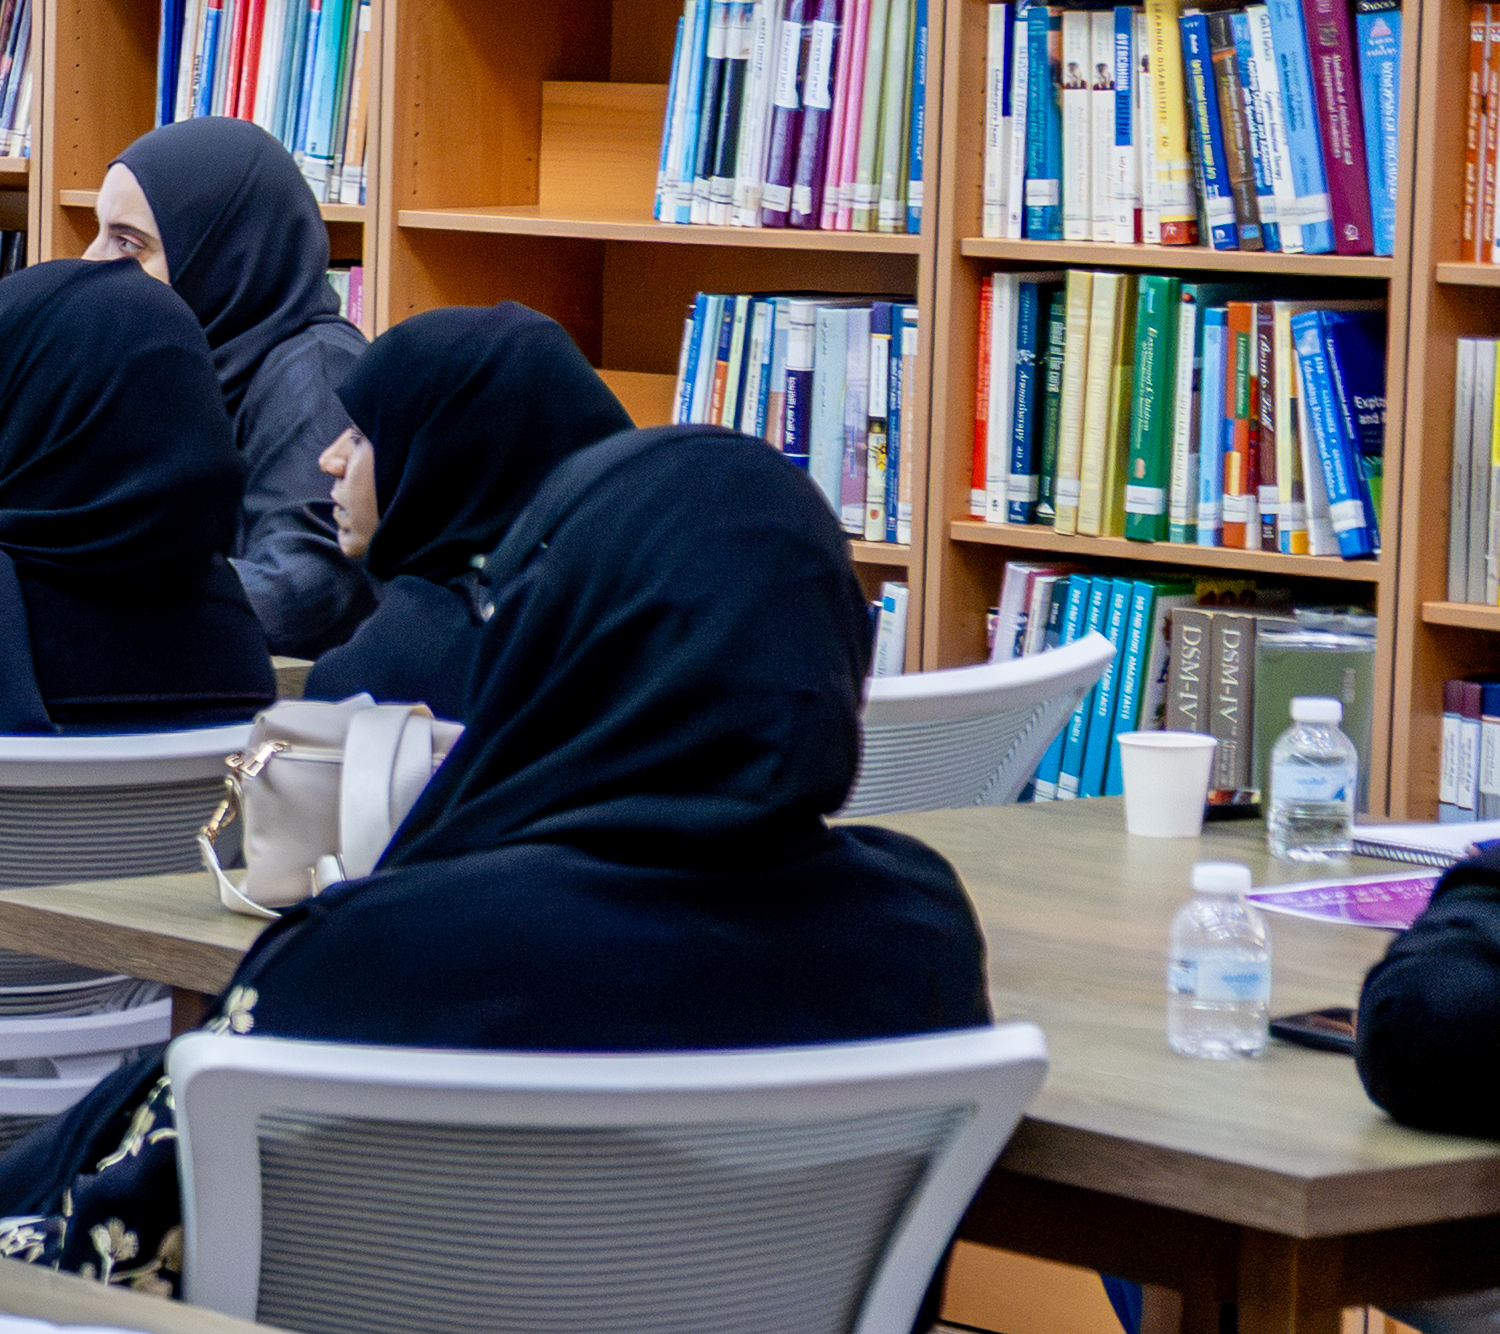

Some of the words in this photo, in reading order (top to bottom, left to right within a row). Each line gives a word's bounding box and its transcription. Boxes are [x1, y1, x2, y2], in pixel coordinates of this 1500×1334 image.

[1152, 3, 1163, 53] LEARNING
[1016, 46, 1027, 88] SENSORY
[1116, 33, 1130, 91] OVERCOMING
[1015, 93, 1026, 132] STORIES
[1117, 93, 1130, 136] DYSLEXIA
[1202, 140, 1214, 165] Language
[1259, 334, 1273, 372] Born
[1259, 375, 1270, 389] to
[1015, 370, 1030, 442] Aromatherapy
[1142, 387, 1156, 431] Children
[1259, 392, 1275, 432] Talk
[1111, 610, 1122, 626] AND
[1133, 611, 1143, 628] AND
[1124, 656, 1137, 694] AMAZING
[1178, 626, 1203, 721] DSM-IV
[1219, 629, 1242, 724] DSM-IV
[1120, 694, 1132, 719] FACTS
